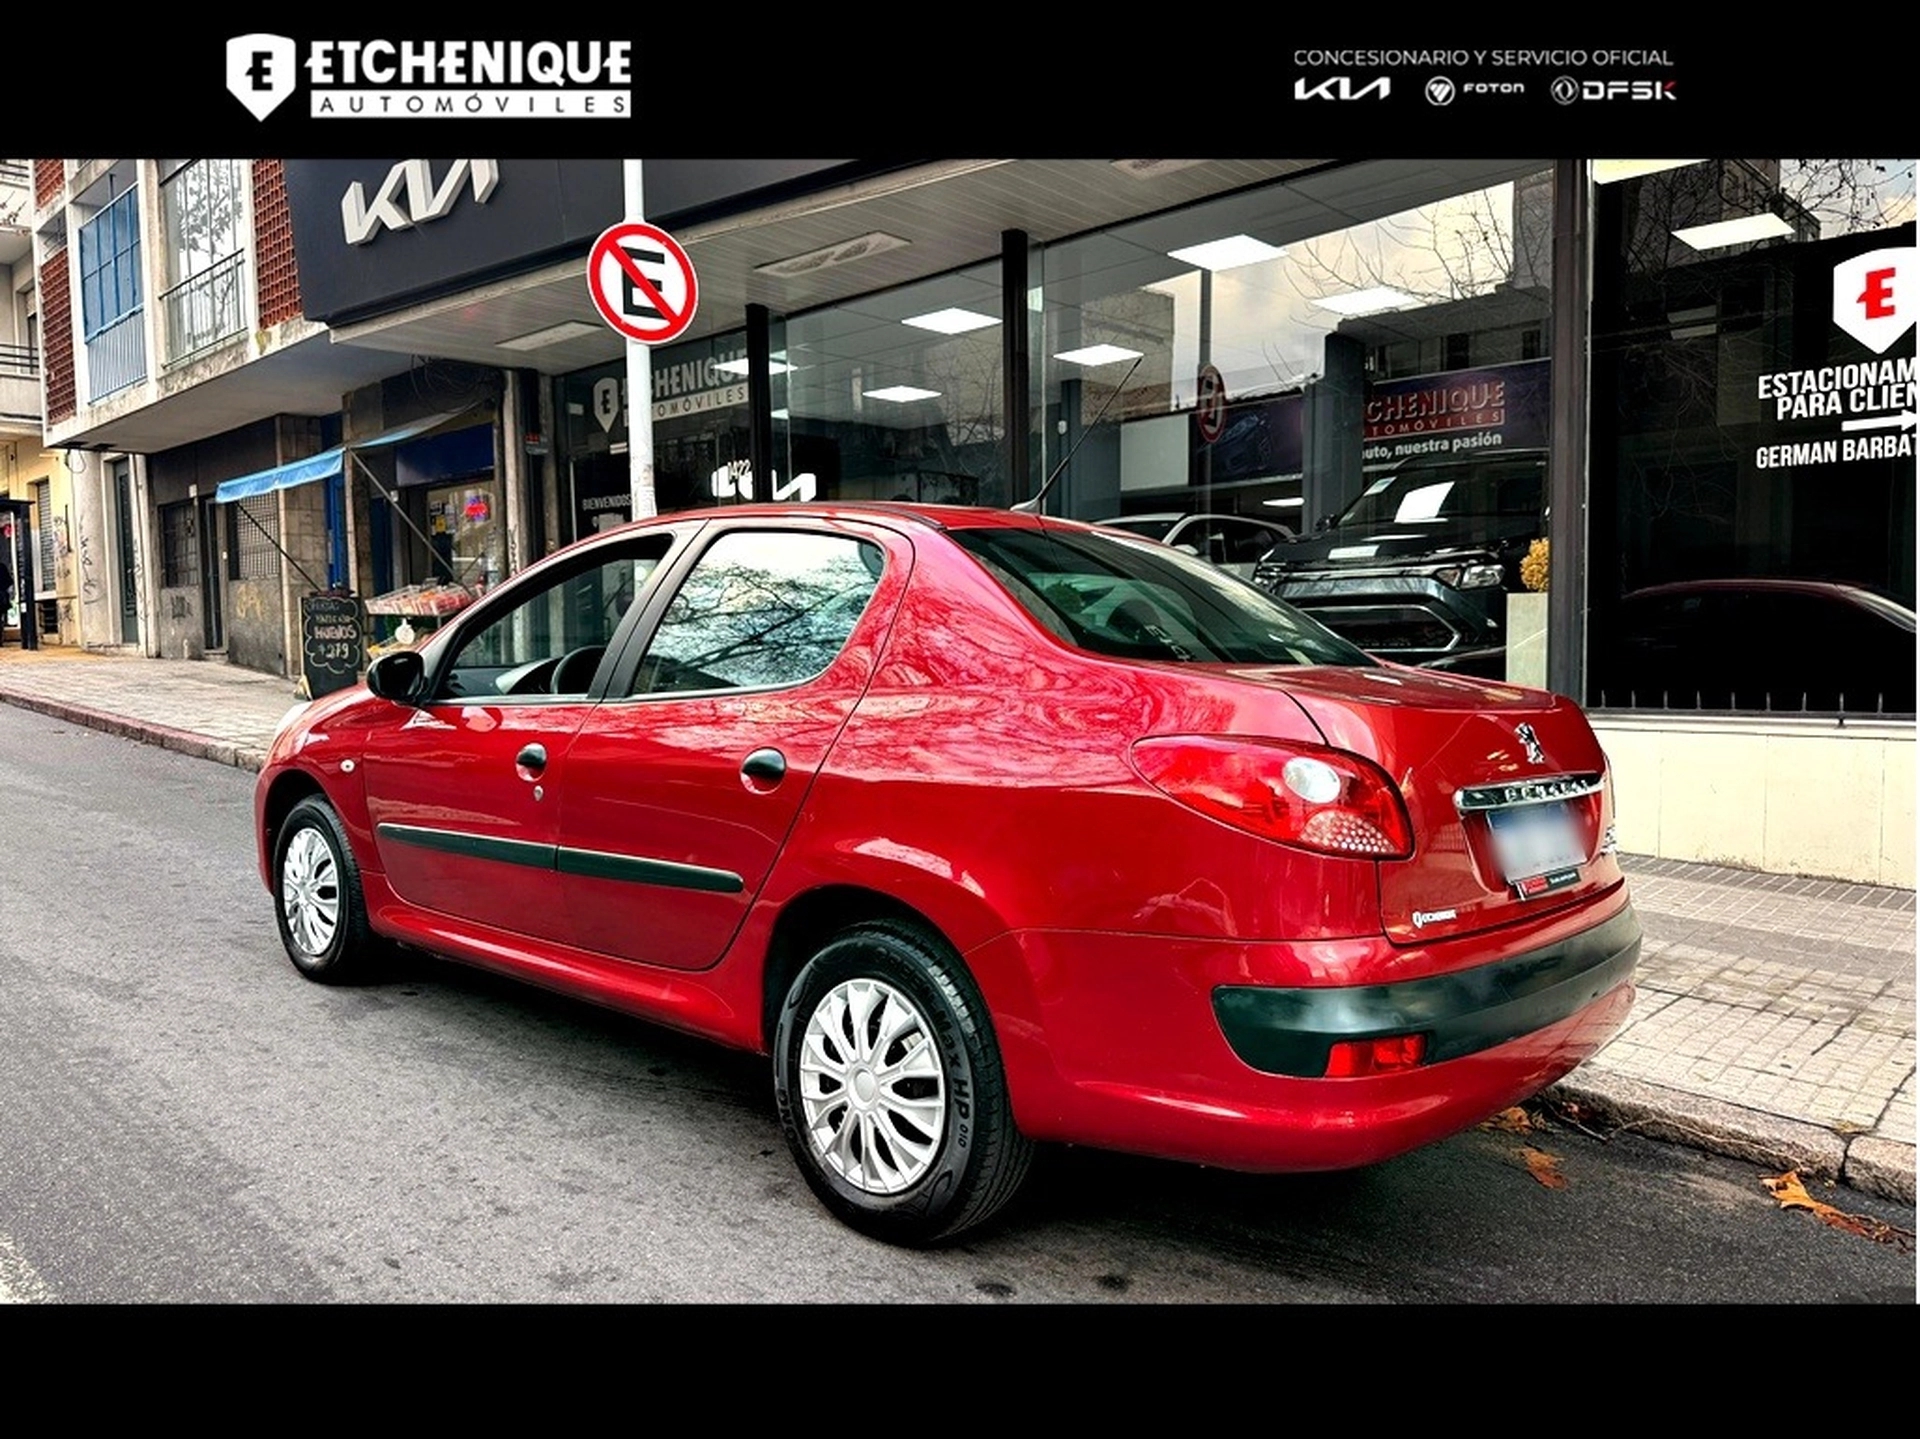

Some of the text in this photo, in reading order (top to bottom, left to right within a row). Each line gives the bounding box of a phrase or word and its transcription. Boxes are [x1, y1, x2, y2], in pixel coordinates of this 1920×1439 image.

[1366, 381, 1505, 423] CHENIQUE
[1777, 391, 1843, 421] PARA
[1395, 439, 1450, 456] nuestra
[1452, 431, 1502, 453] pasión
[1756, 440, 1837, 469] GERMAN
